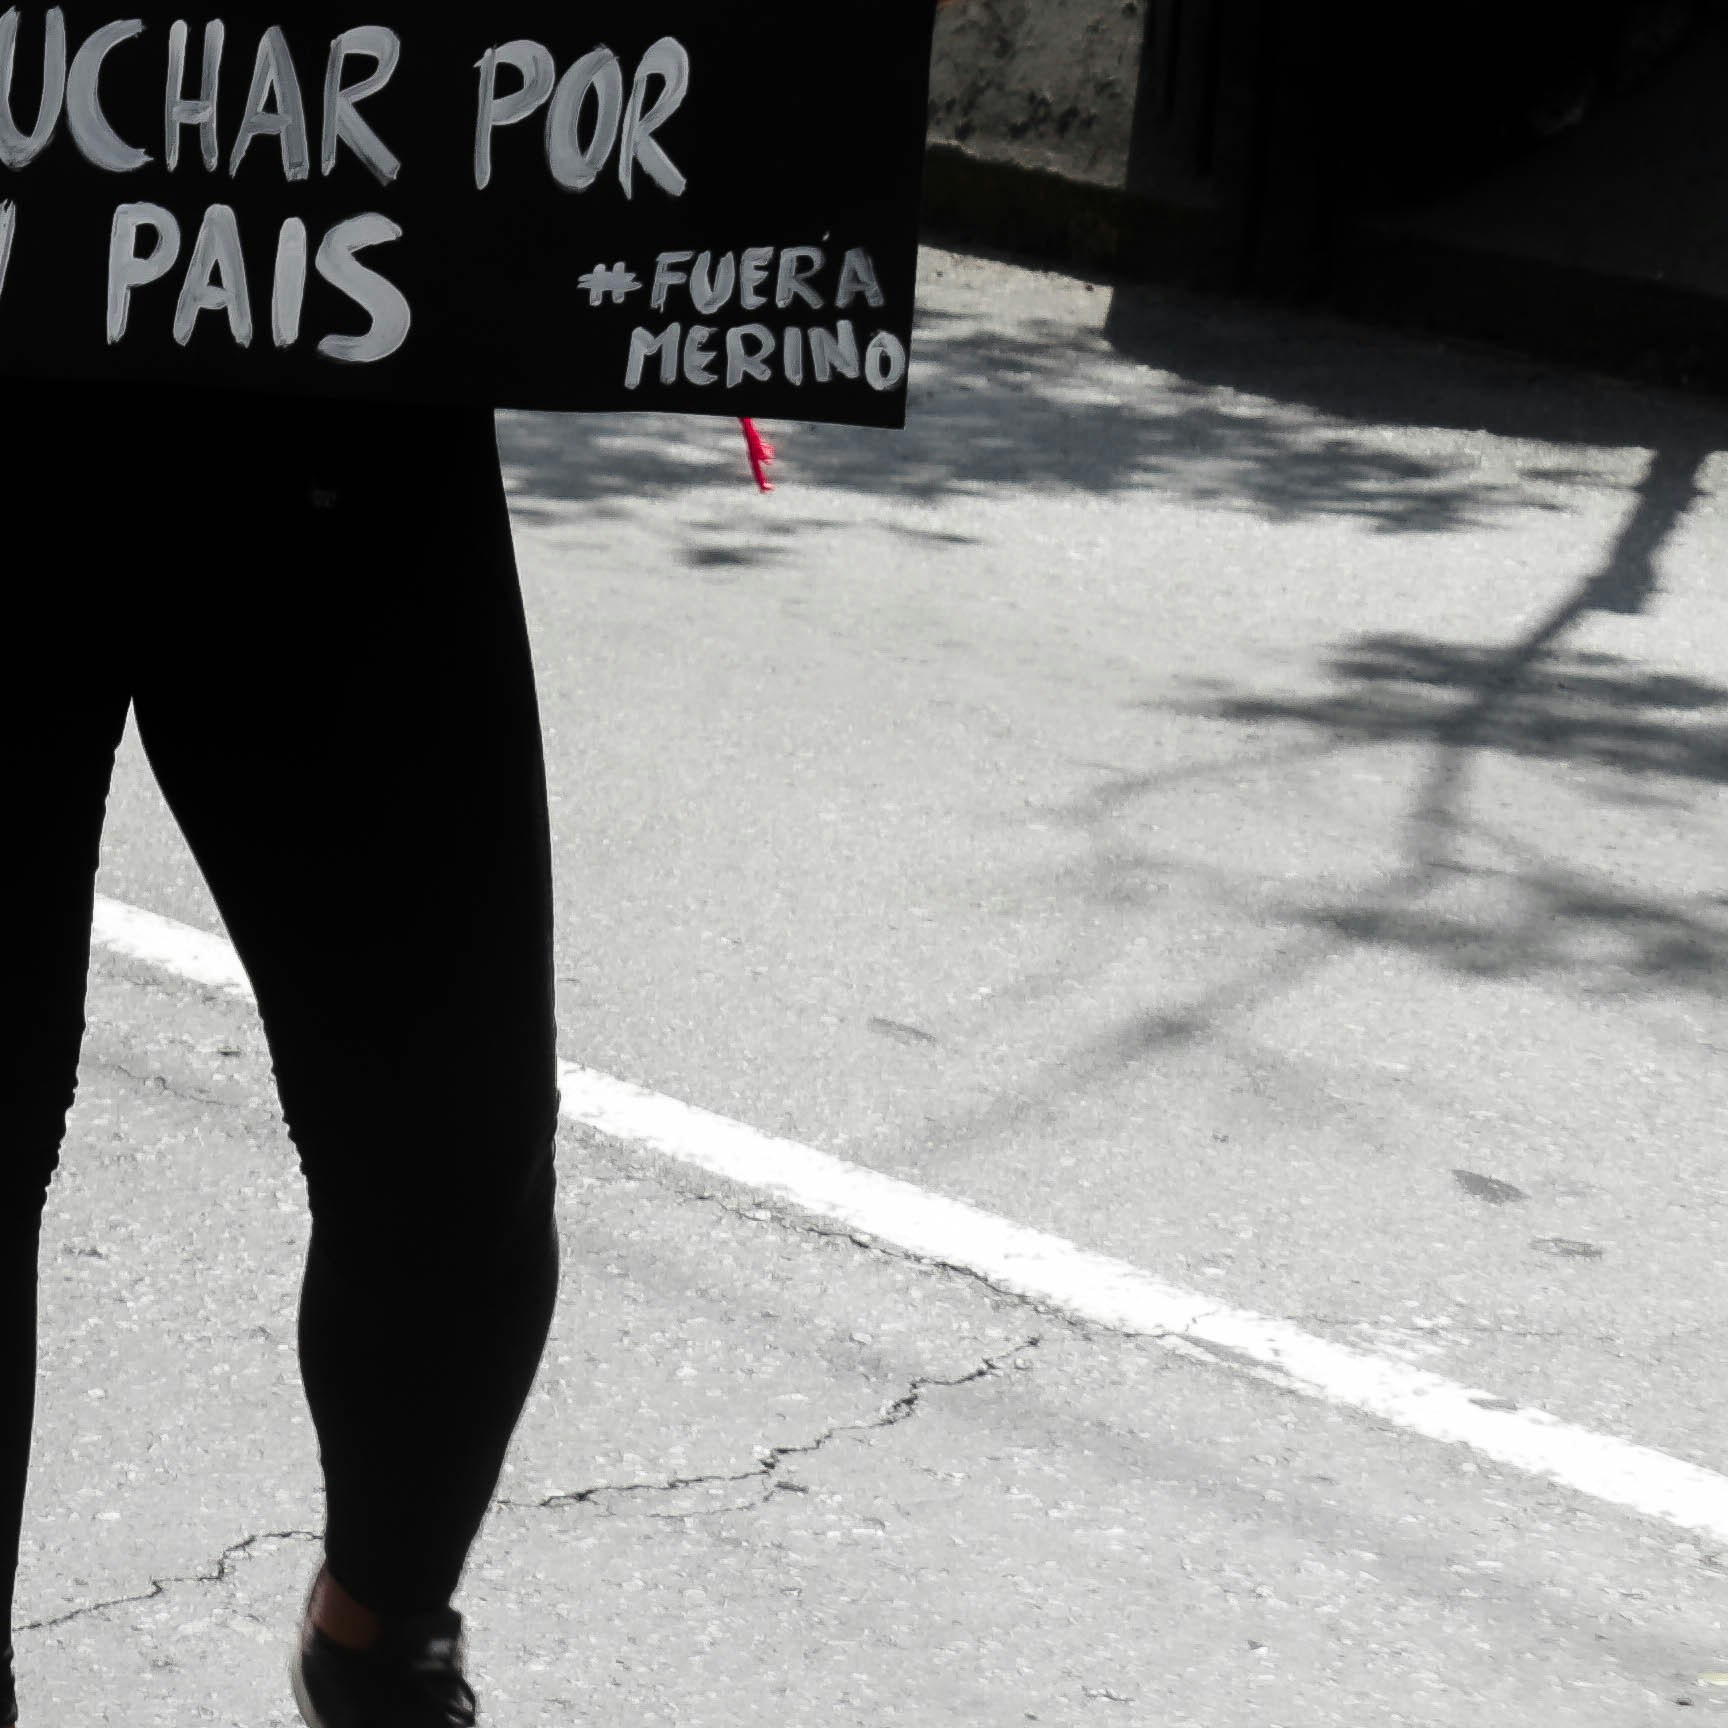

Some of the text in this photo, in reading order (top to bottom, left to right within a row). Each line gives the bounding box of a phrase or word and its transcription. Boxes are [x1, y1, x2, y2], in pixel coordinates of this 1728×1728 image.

[475, 38, 688, 199] POR
[108, 202, 410, 361] PAIS
[577, 246, 884, 314] #FUERA
[624, 320, 905, 391] MERINO
